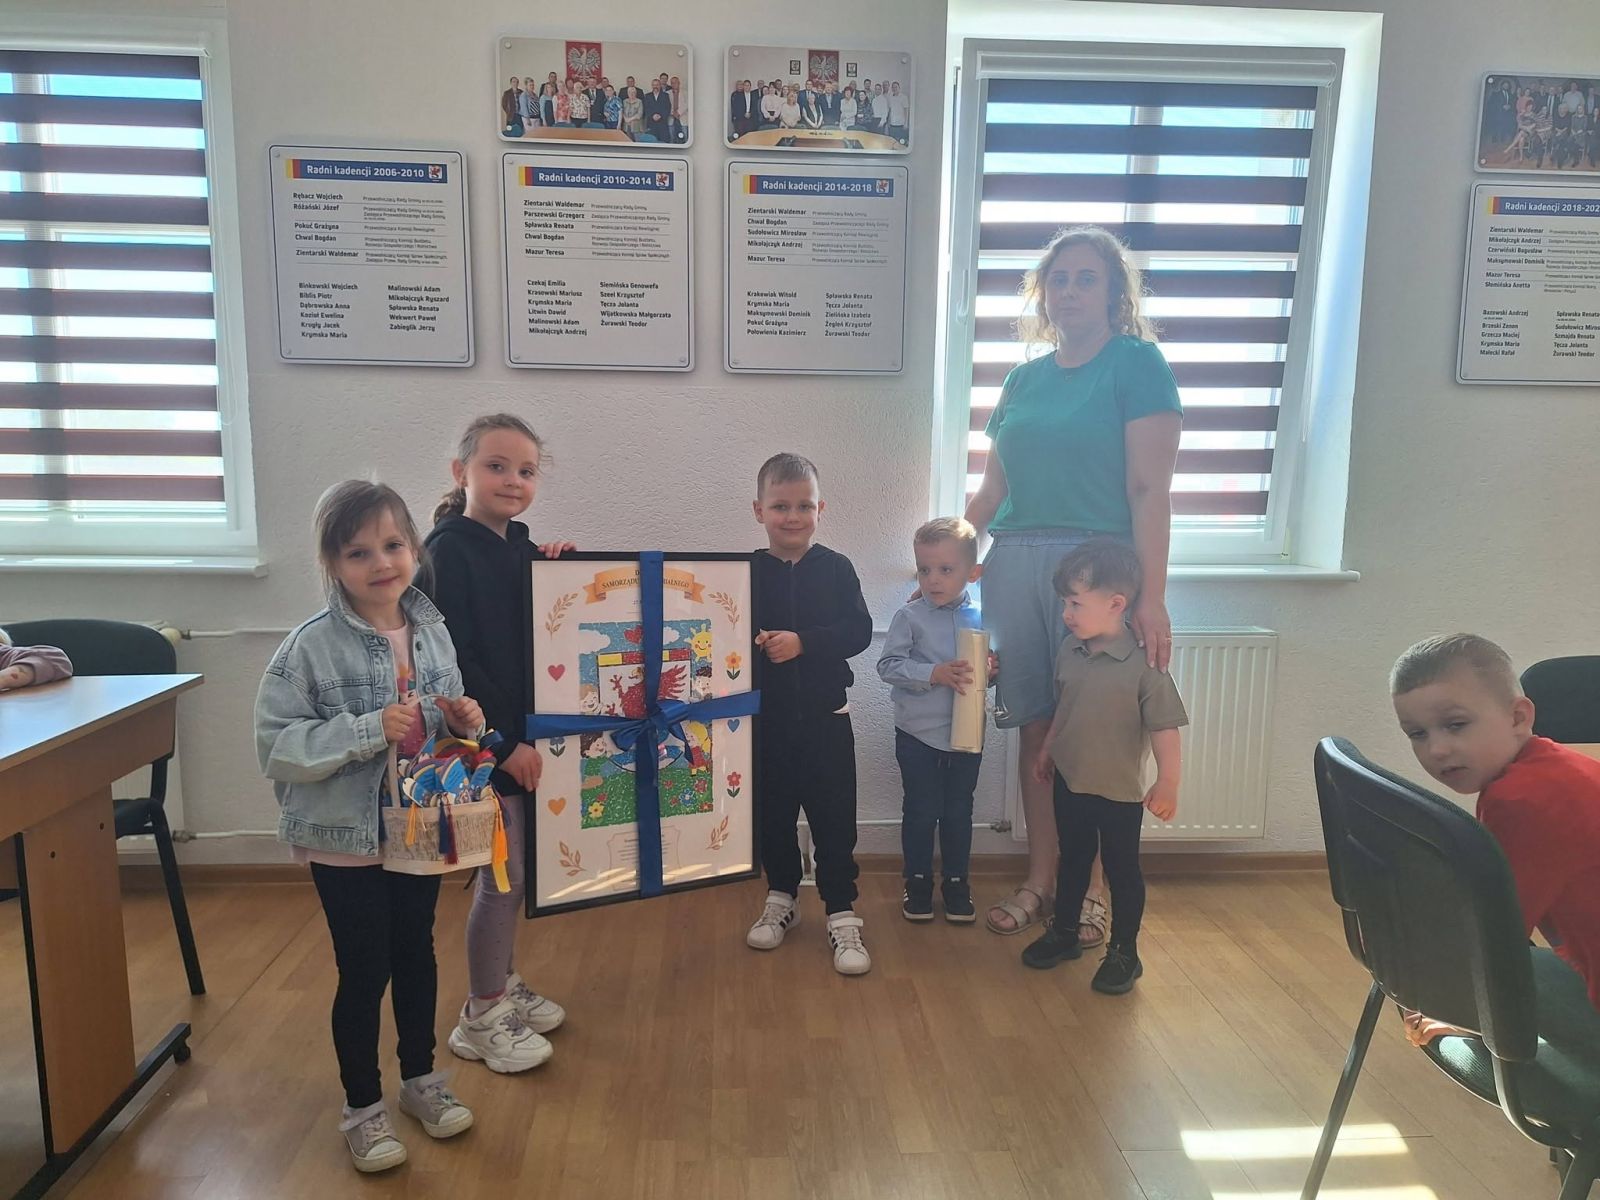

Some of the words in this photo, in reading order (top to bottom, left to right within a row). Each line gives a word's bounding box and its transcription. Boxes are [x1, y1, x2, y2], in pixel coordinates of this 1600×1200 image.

[307, 165, 332, 175] Radni
[334, 166, 371, 178] kadencji
[374, 168, 424, 178] 2006-2010
[539, 173, 563, 182] Radni
[565, 174, 600, 184] kadencji
[603, 176, 651, 185] 2010-2014
[763, 181, 786, 190] Radni
[788, 182, 823, 192] kadencji
[825, 183, 872, 192] 2014-2018
[1528, 203, 1560, 212] kadencji
